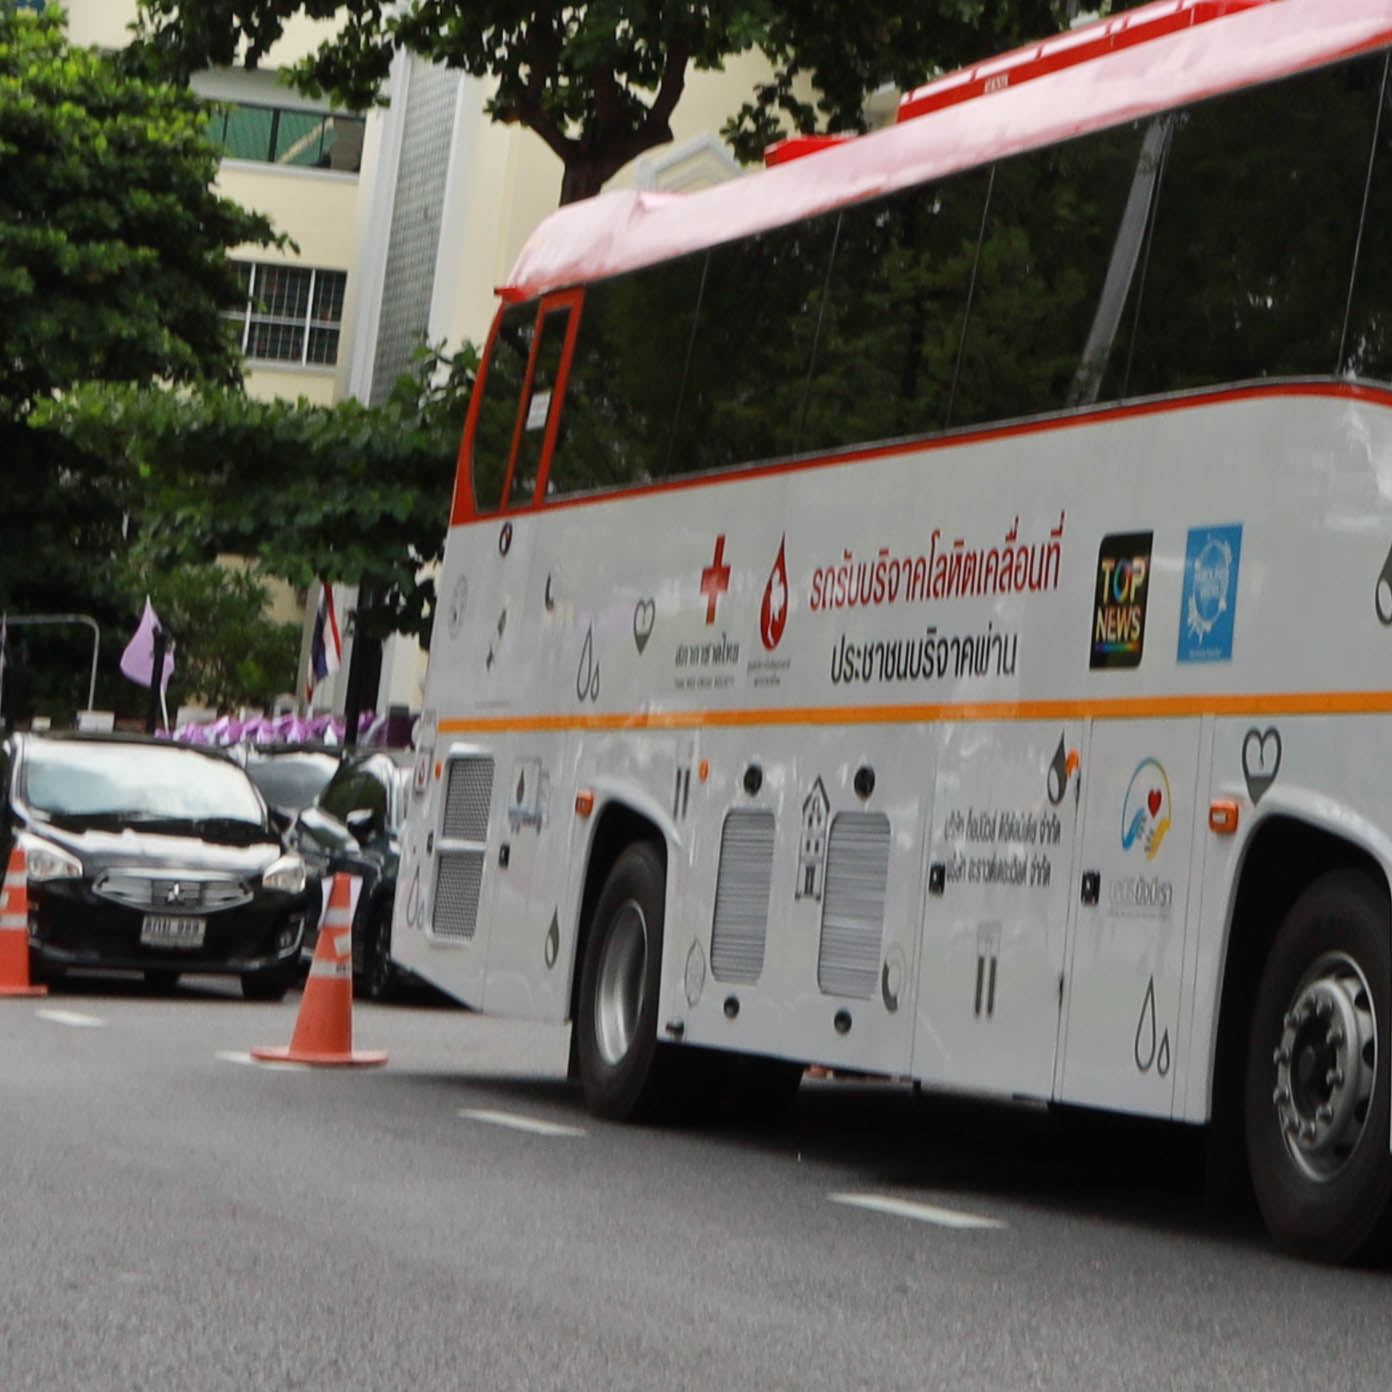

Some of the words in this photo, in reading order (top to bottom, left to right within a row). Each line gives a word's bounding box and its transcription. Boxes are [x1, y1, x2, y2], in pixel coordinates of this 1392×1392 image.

[810, 509, 1065, 611] รถรับบริจาคโลหิตเคลื่อนที่
[1101, 556, 1146, 603] TOP
[1095, 606, 1141, 642] NEWS
[831, 621, 1017, 684] ประชาชนบริจาคผ่าน
